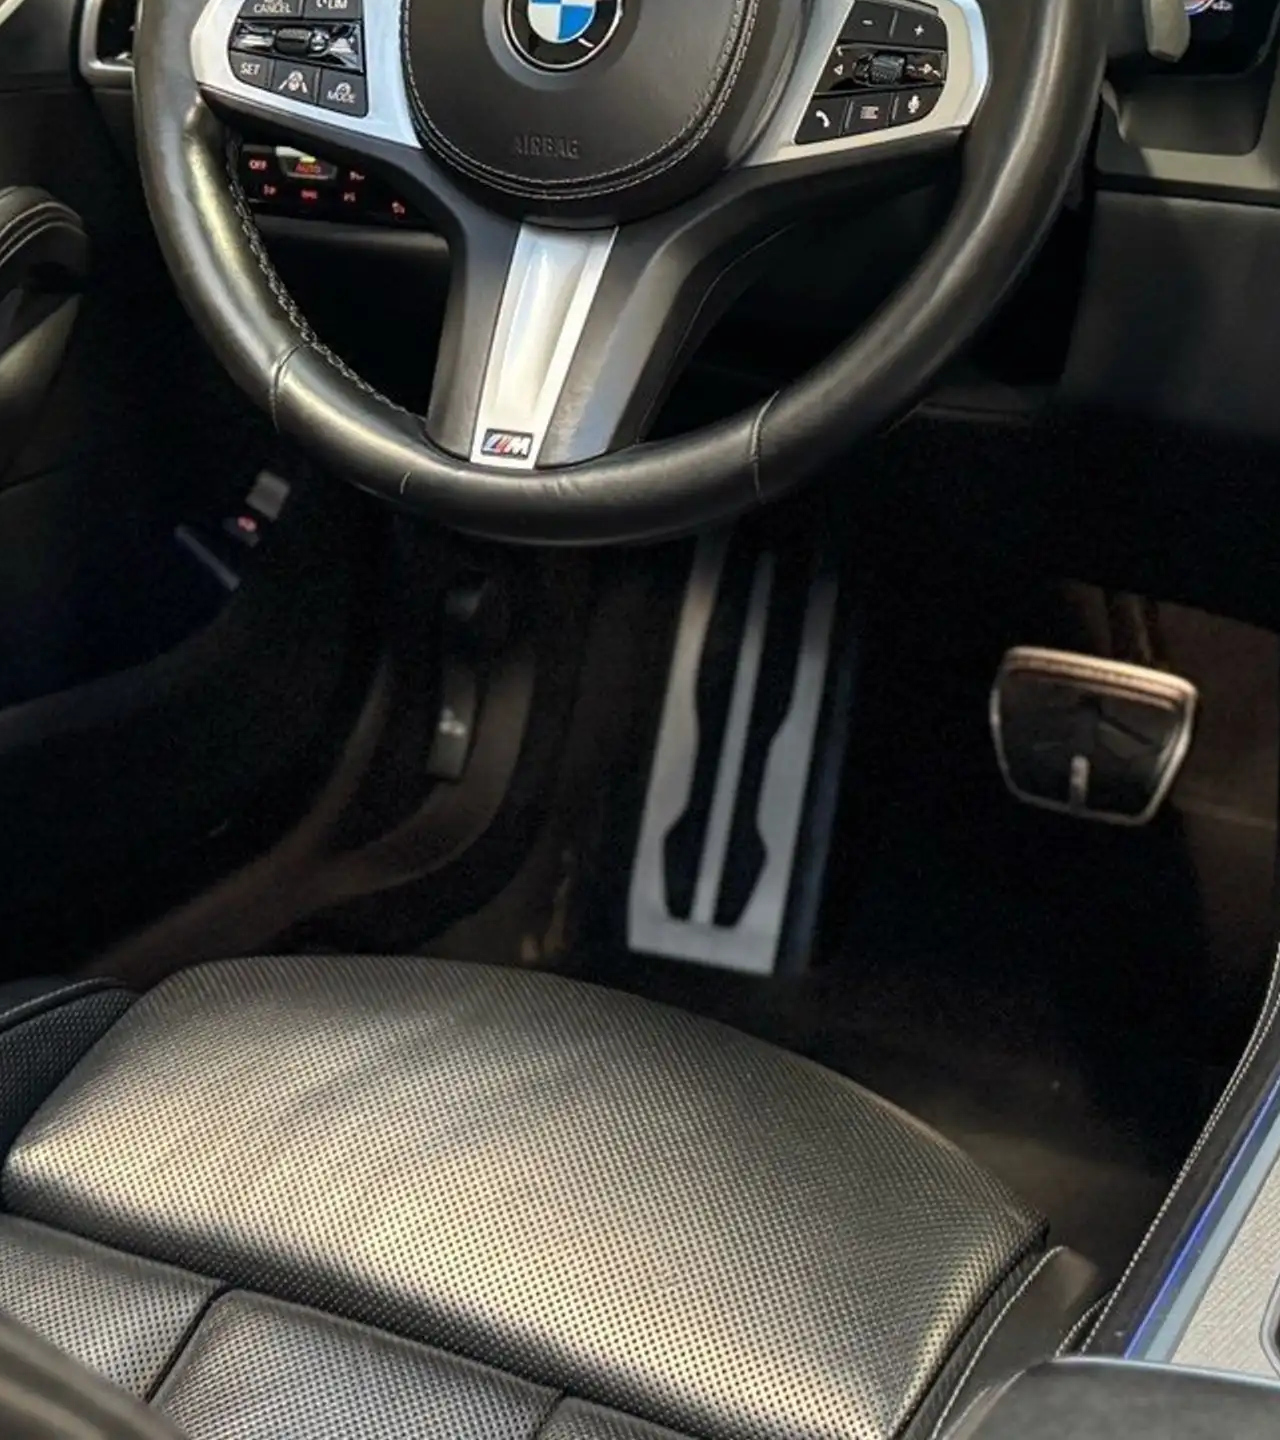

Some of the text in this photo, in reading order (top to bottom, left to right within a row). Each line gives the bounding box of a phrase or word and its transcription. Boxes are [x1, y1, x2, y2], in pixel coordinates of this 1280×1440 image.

[253, 3, 292, 14] CANCEL
[240, 62, 260, 76] SET
[513, 134, 581, 160] AIRBAG
